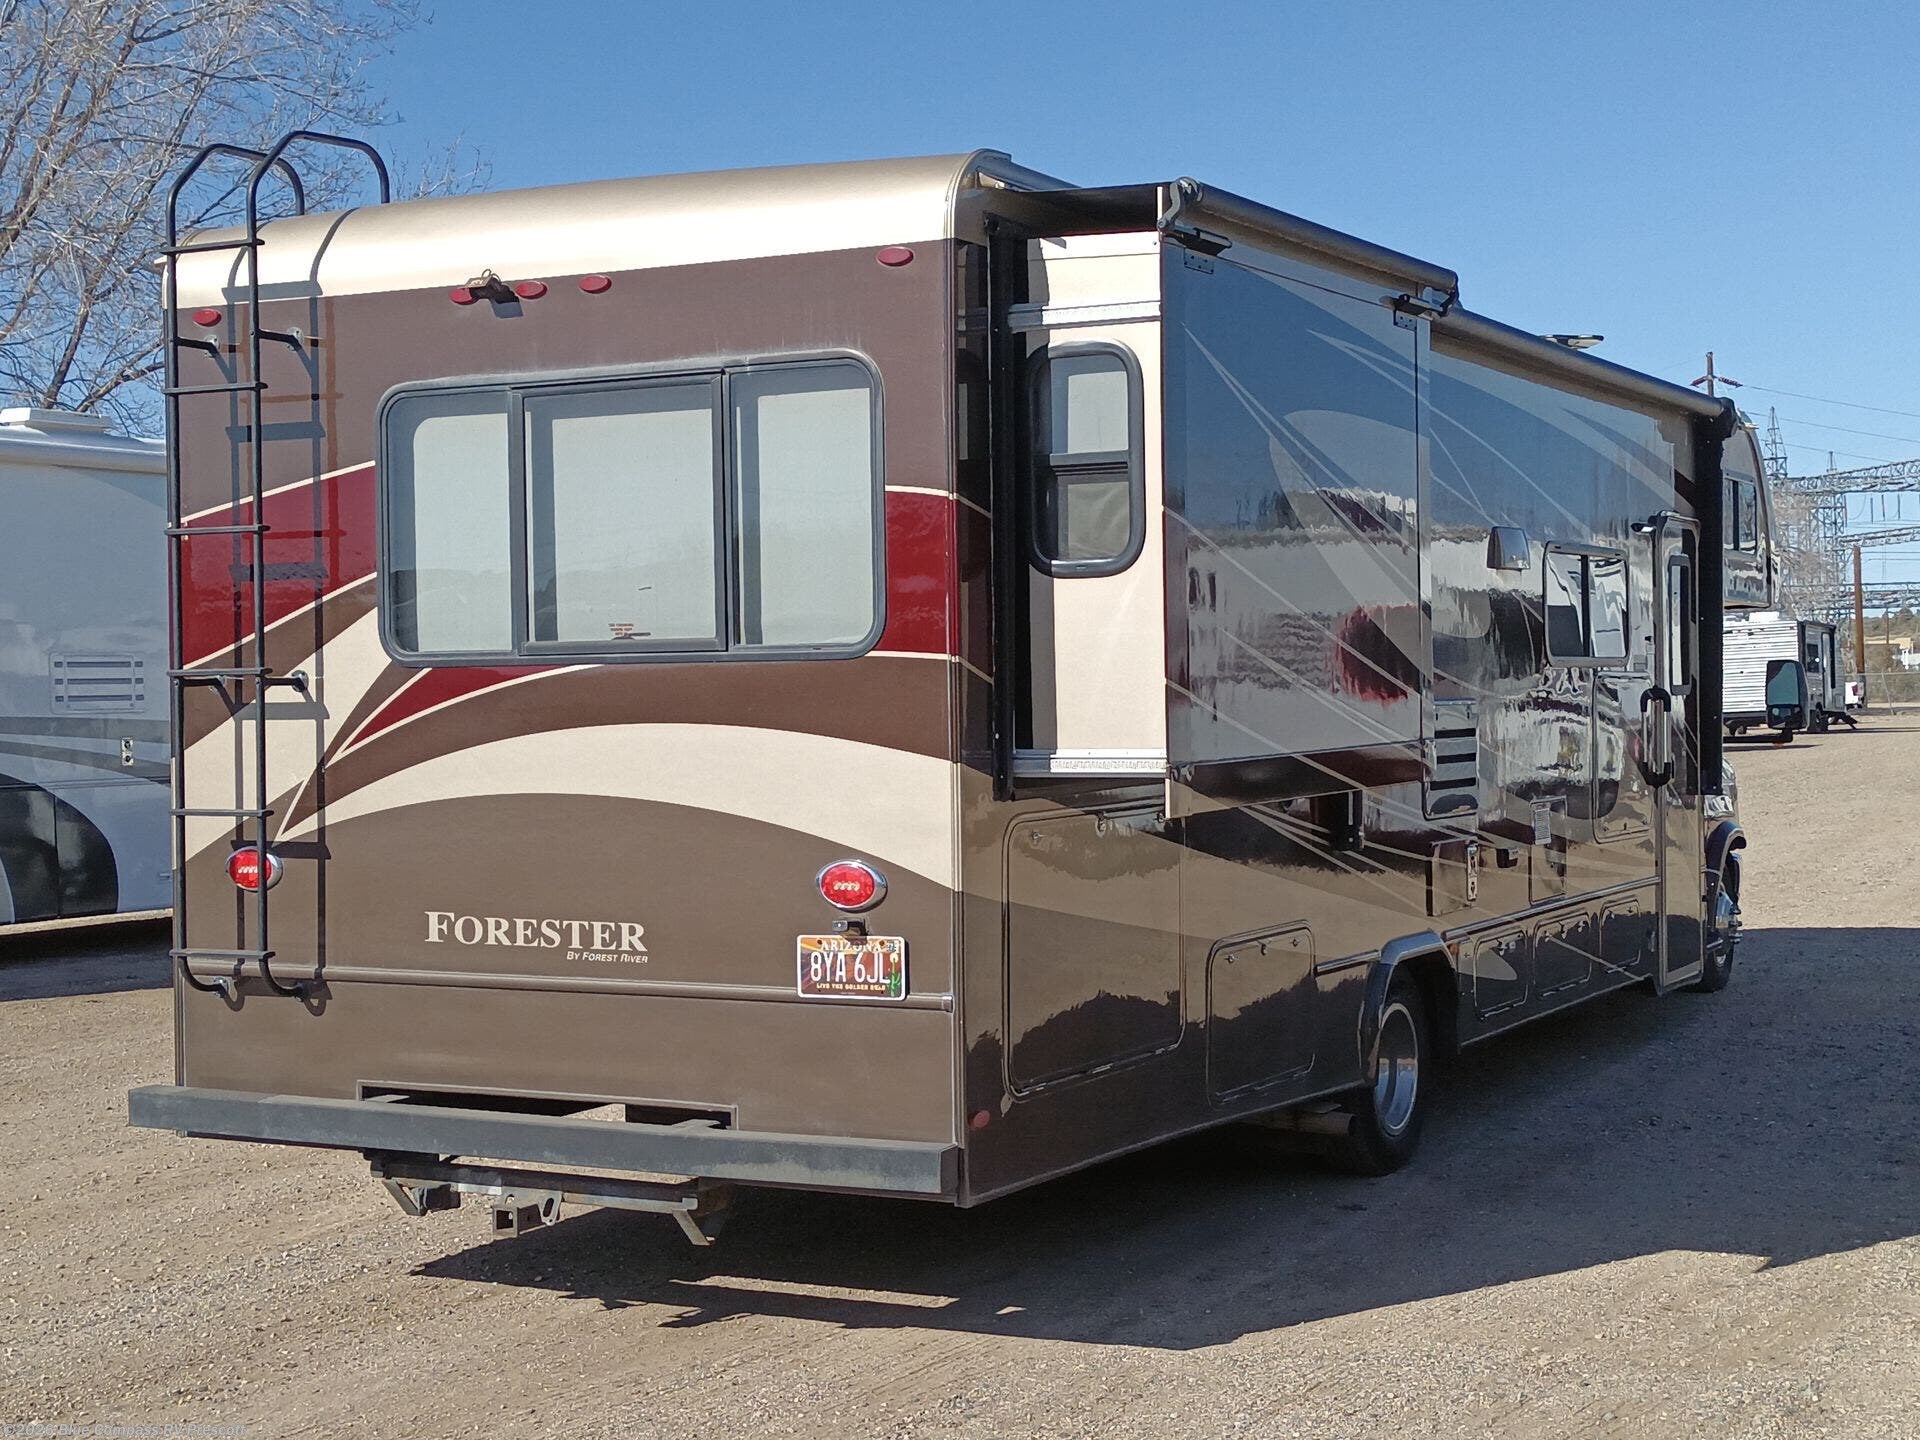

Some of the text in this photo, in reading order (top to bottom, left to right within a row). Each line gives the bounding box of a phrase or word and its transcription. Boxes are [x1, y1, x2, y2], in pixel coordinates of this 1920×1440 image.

[424, 911, 648, 951] FORESTER
[582, 951, 618, 962] FOREST
[620, 953, 649, 964] RIVER
[820, 940, 882, 952] ARIZONA
[810, 951, 891, 984] 8YA 6JL
